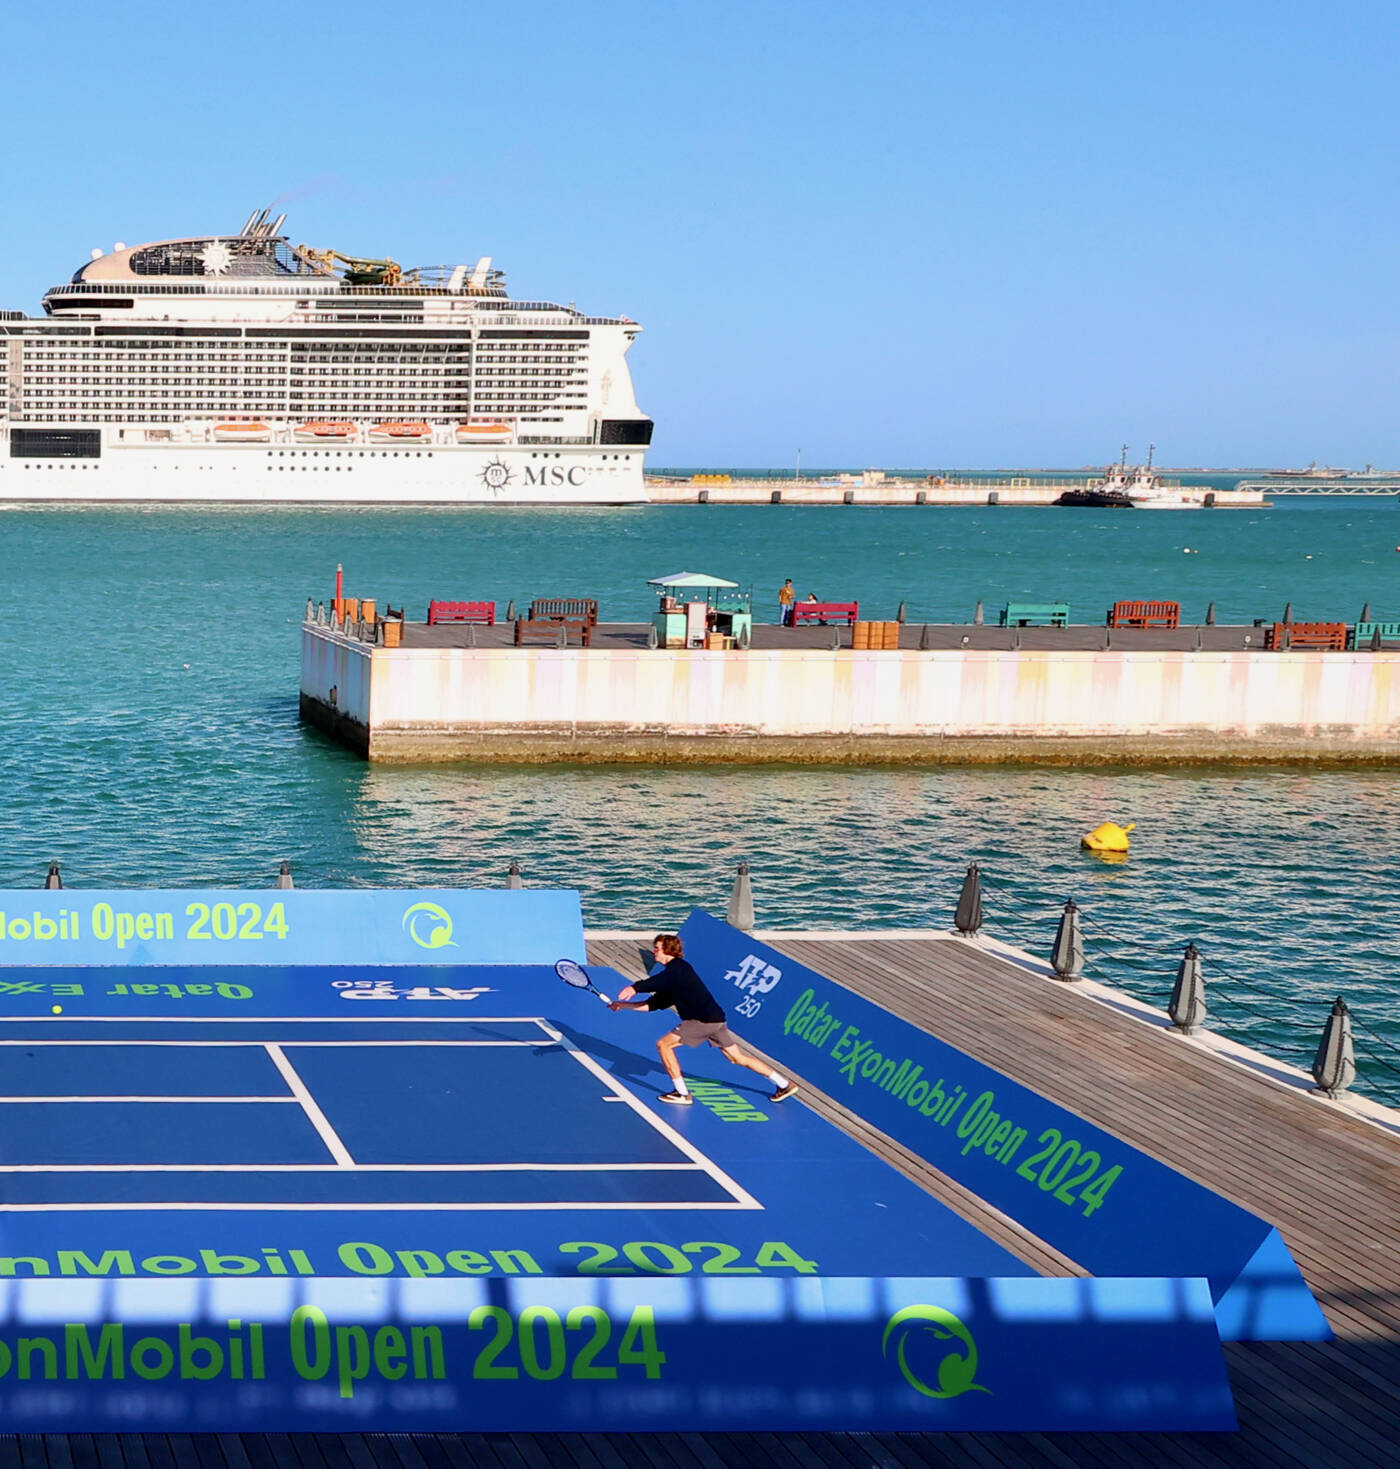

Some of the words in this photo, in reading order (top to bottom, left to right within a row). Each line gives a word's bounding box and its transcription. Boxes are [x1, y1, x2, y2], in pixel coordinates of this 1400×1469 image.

[524, 466, 586, 486] MSC
[91, 902, 175, 949] Open
[185, 902, 290, 940] 2024
[107, 982, 254, 999] Qatar
[724, 954, 782, 996] ATP
[734, 994, 762, 1019] 250
[784, 989, 841, 1048] Qatar
[830, 1025, 968, 1127] ExxonMobil
[956, 1091, 1028, 1165] Open
[1015, 1128, 1124, 1218] 2024
[337, 1242, 543, 1278] Open
[559, 1242, 818, 1274] 2024
[289, 1305, 446, 1398] Open
[467, 1305, 667, 1381] 2024
